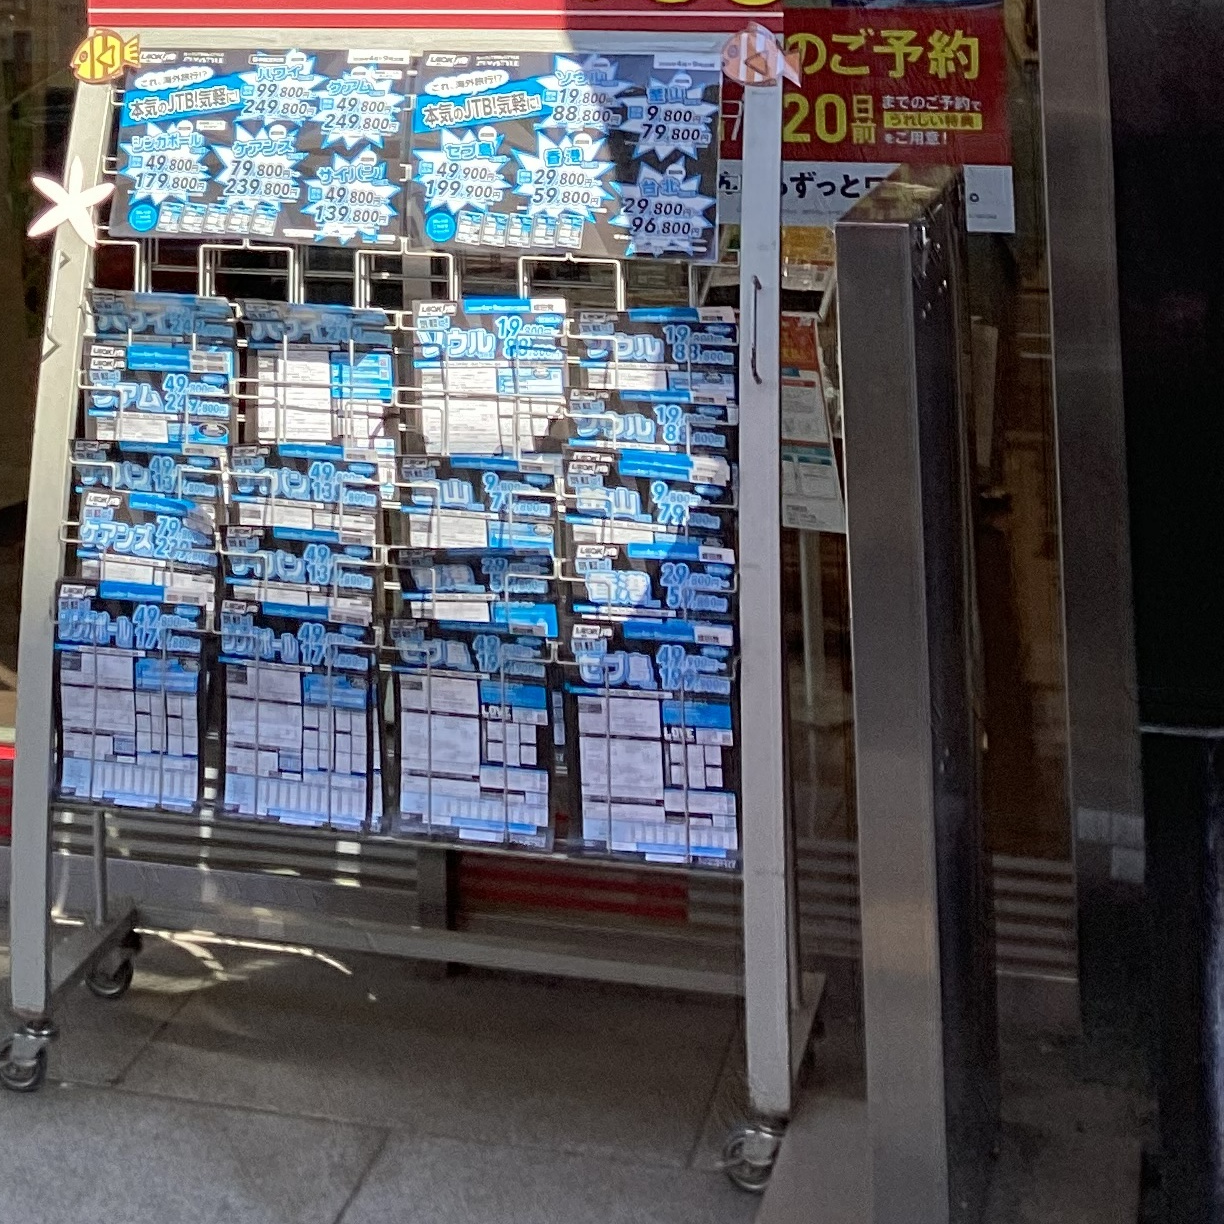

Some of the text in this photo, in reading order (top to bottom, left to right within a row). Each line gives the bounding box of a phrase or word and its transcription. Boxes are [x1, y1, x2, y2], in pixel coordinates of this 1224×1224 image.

[257, 64, 303, 81] ハワイ
[328, 79, 374, 95] グアム
[882, 94, 982, 112] までのご予約で
[233, 139, 295, 158] ケアンズ
[545, 148, 582, 166] 香港
[643, 178, 678, 196] 台北
